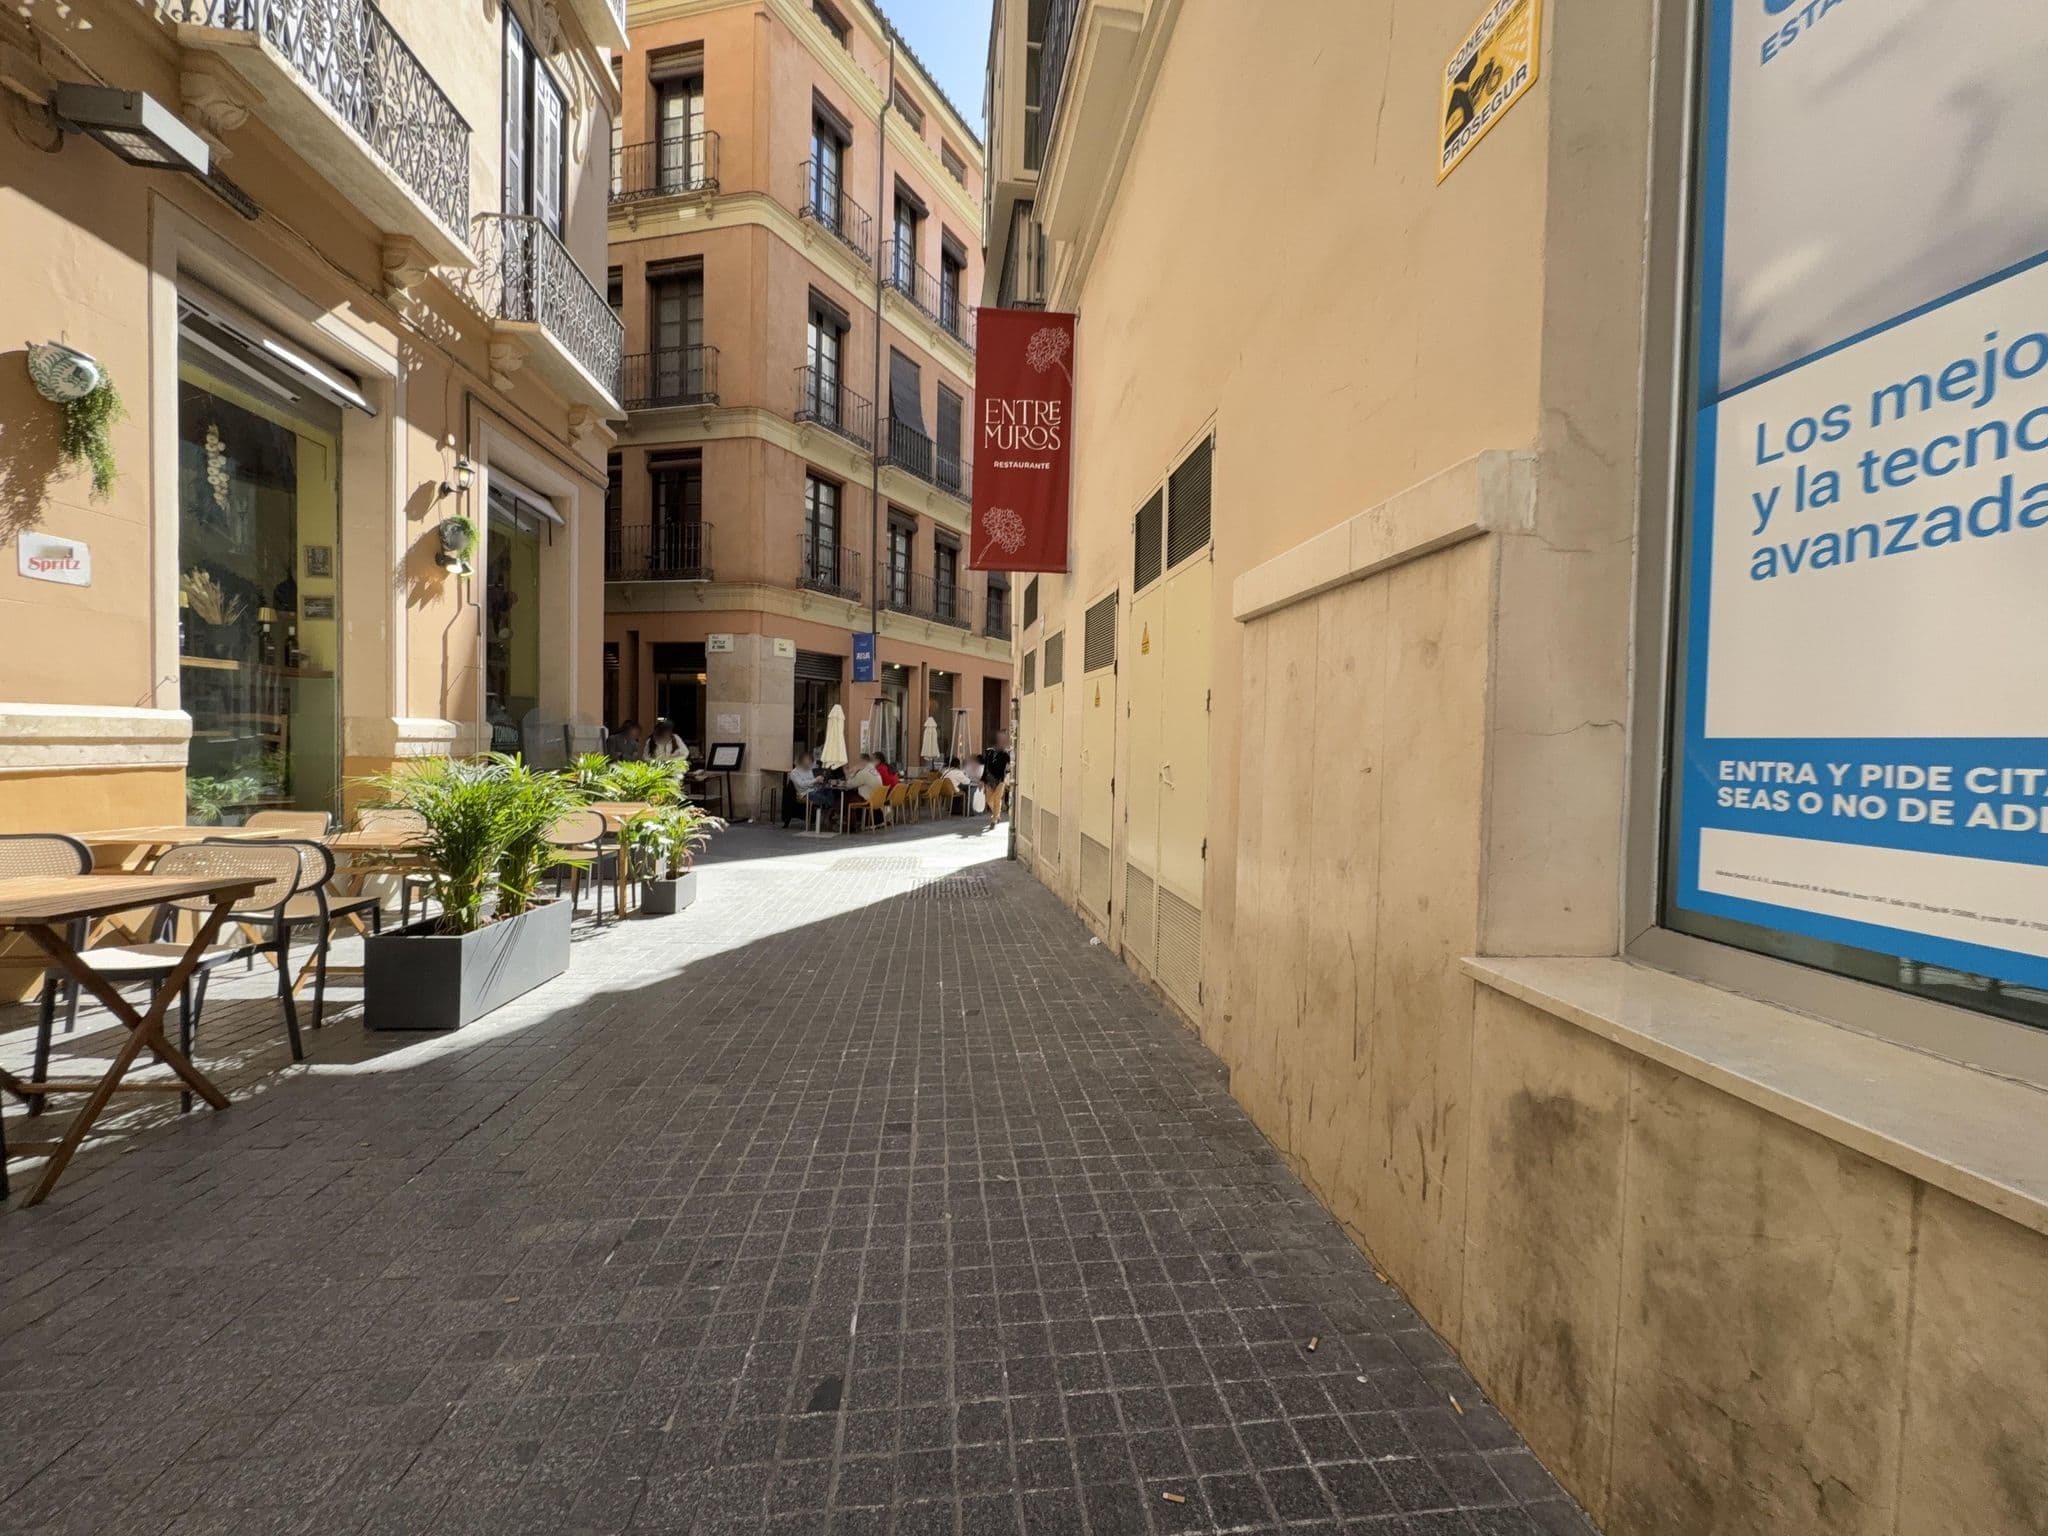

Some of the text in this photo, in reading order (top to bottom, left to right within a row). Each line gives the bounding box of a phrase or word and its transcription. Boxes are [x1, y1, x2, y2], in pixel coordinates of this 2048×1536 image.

[1442, 63, 1528, 168] PROSEGUR
[985, 398, 1061, 426] ENTRE
[1755, 330, 2048, 466] Los mejo
[984, 424, 1061, 451] MUROS
[993, 460, 1051, 470] RESTAURANTE
[1751, 486, 1781, 536] y
[1795, 465, 1841, 513] la
[1750, 473, 2048, 581] avanzada
[28, 557, 80, 572] Spritz
[1719, 760, 2048, 797] ENTRA Y PIDE CIT
[1717, 786, 1790, 812] SEAS
[1797, 791, 1823, 815] O
[1831, 794, 1888, 820] NO
[1898, 798, 1954, 826] DE
